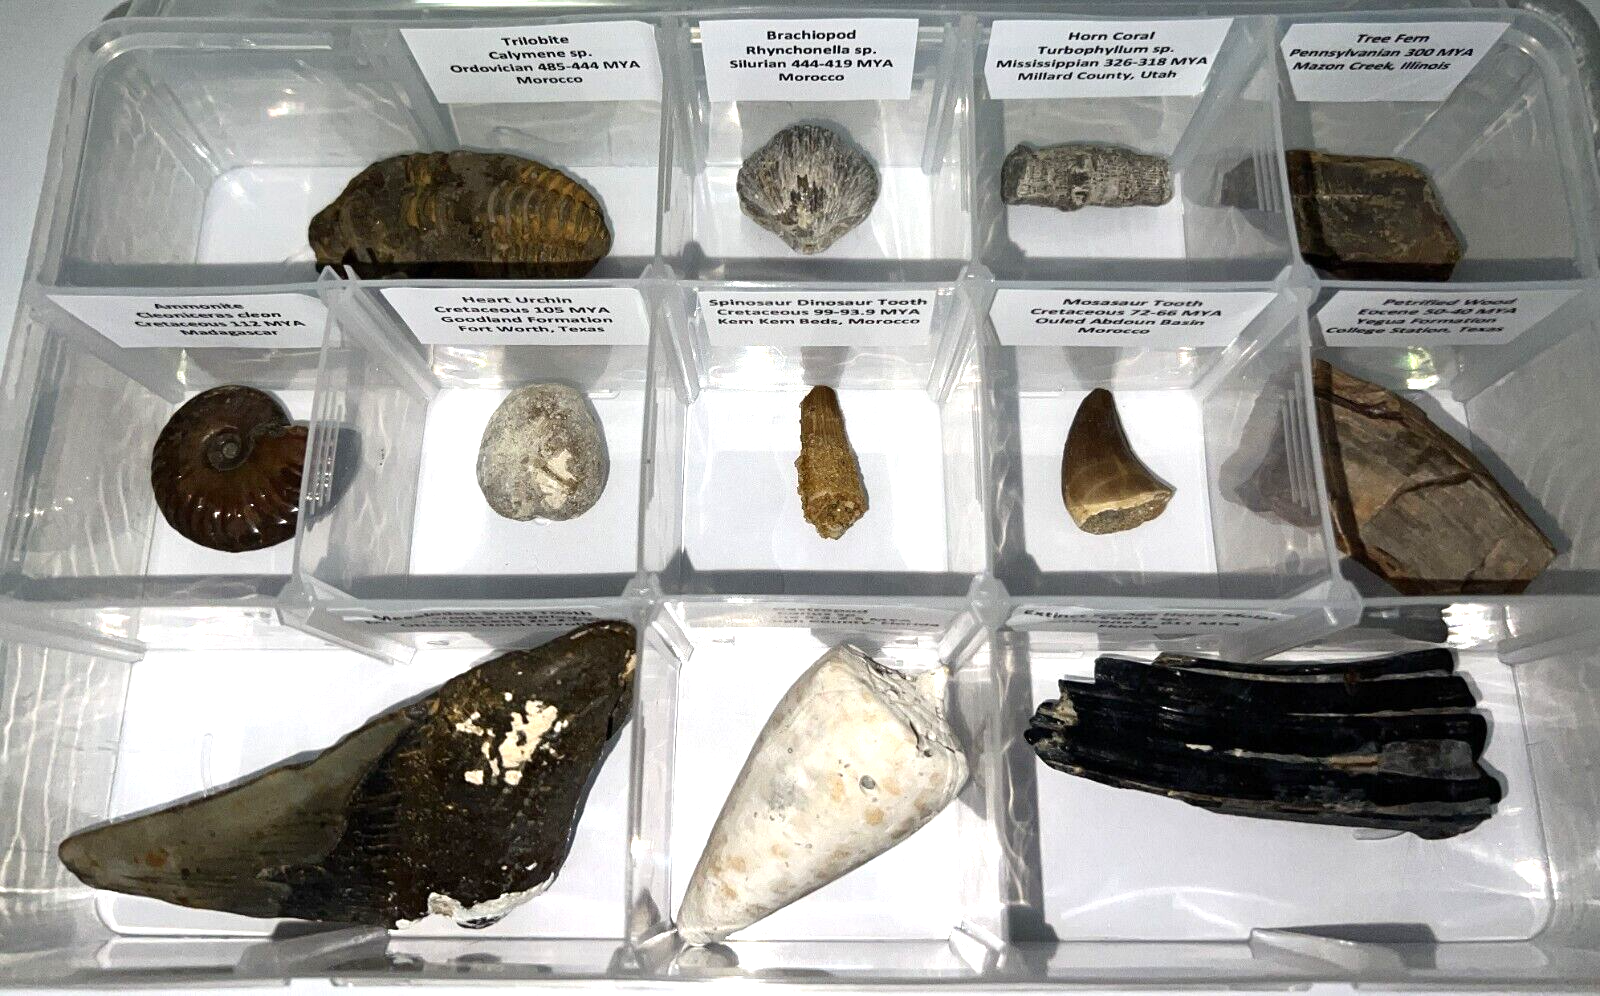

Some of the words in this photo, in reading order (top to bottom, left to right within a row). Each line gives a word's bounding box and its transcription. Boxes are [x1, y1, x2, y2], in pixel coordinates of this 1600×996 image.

[767, 30, 856, 41] Brachiopod
[1069, 32, 1108, 40] Horn
[1113, 32, 1155, 40] Coral
[1356, 35, 1391, 43] Tree
[501, 36, 569, 47] Trilobite
[489, 50, 565, 60] Calymene
[570, 50, 592, 59] sp.
[747, 46, 850, 56] Rhynchonella
[855, 47, 876, 56] sp.
[1038, 46, 1149, 55] Turbophyllum
[1153, 46, 1174, 54] sp.
[1290, 49, 1400, 58] Pennsylvanian
[450, 64, 533, 73] Ordovician
[538, 62, 599, 71] 485-444
[603, 61, 640, 69] MYA
[730, 60, 786, 68] Silurian
[791, 60, 852, 68] 444-419
[996, 60, 1099, 69] Mississippian
[1104, 58, 1166, 67] 326-318
[1171, 57, 1207, 65] MYA
[1292, 62, 1344, 70] Mazon
[1349, 62, 1395, 71] Creek,
[1400, 61, 1450, 70] Illinois
[517, 76, 583, 84] Morocco
[1018, 72, 1073, 80] Millard
[1077, 72, 1134, 82] County,
[1140, 71, 1176, 79] Utah
[709, 299, 792, 307] Spinosaur
[1357, 318, 1405, 326] Yegua
[180, 329, 278, 337] Madagascar
